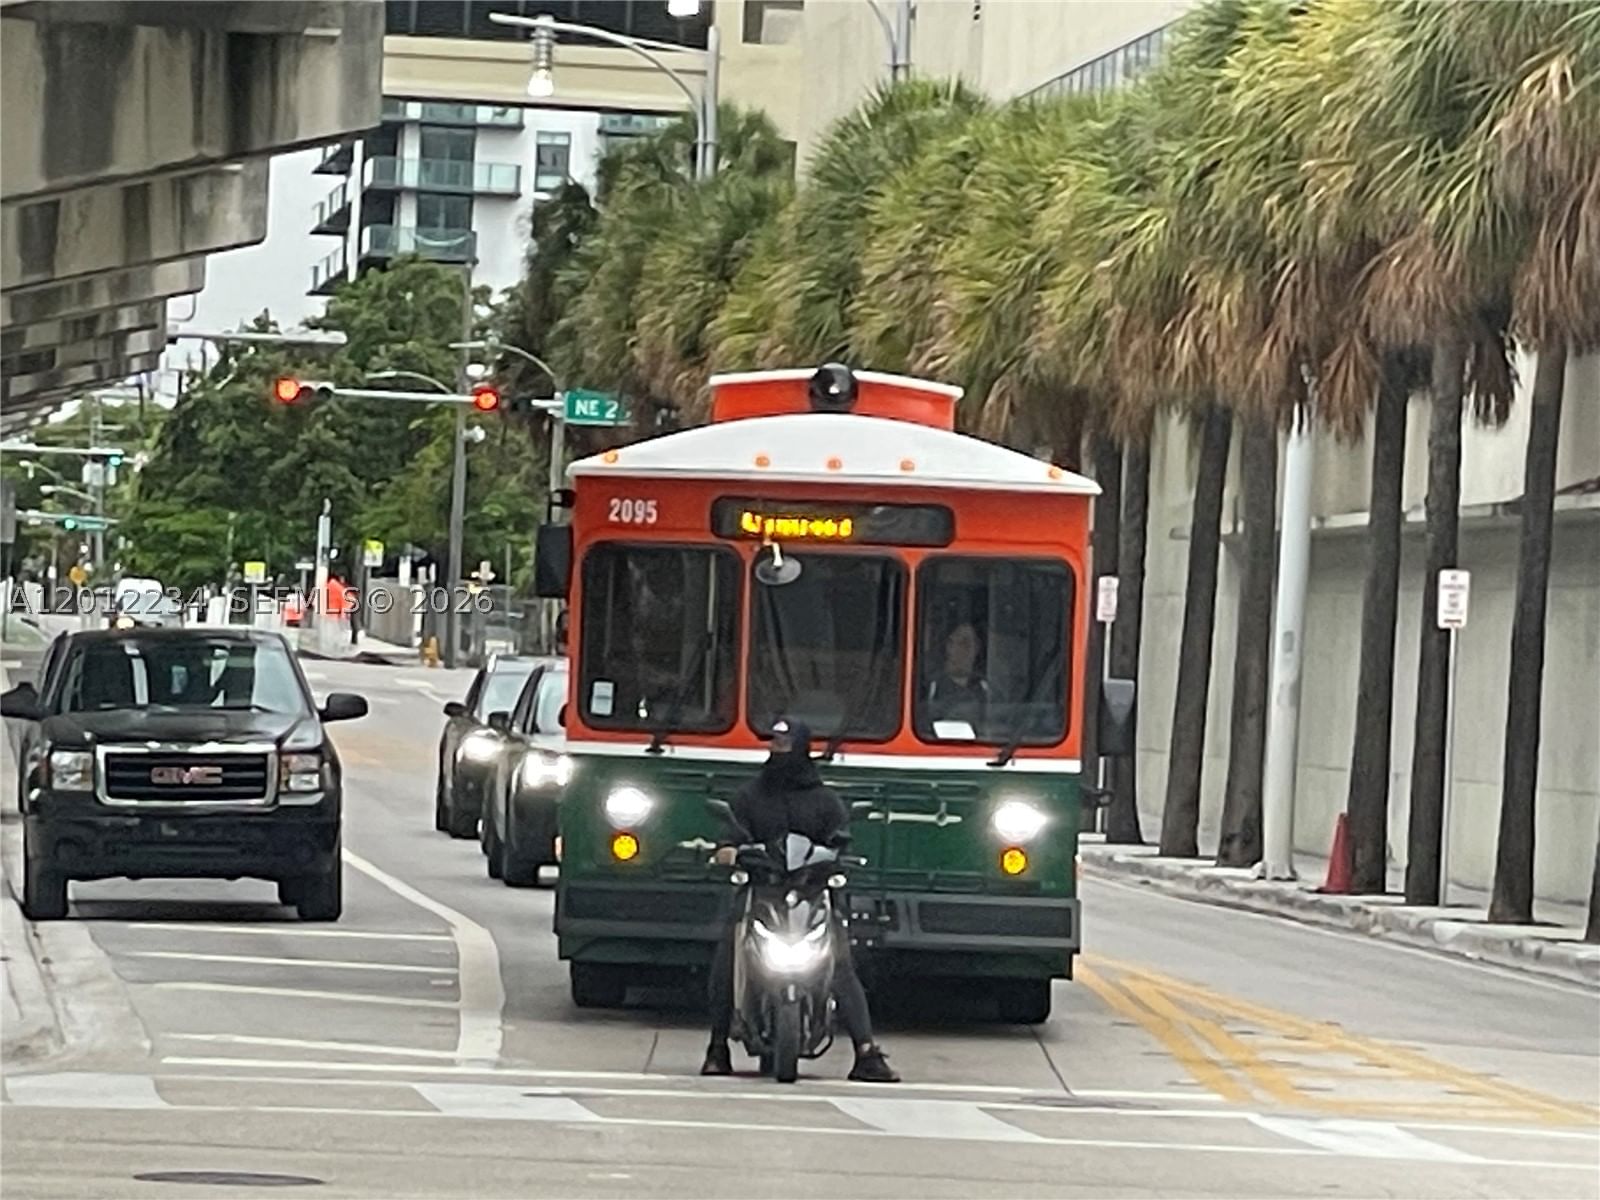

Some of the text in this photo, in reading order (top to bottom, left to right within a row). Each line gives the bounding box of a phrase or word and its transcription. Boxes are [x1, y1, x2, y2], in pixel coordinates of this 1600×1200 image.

[574, 399, 619, 419] NE 2
[608, 498, 658, 524] 2095
